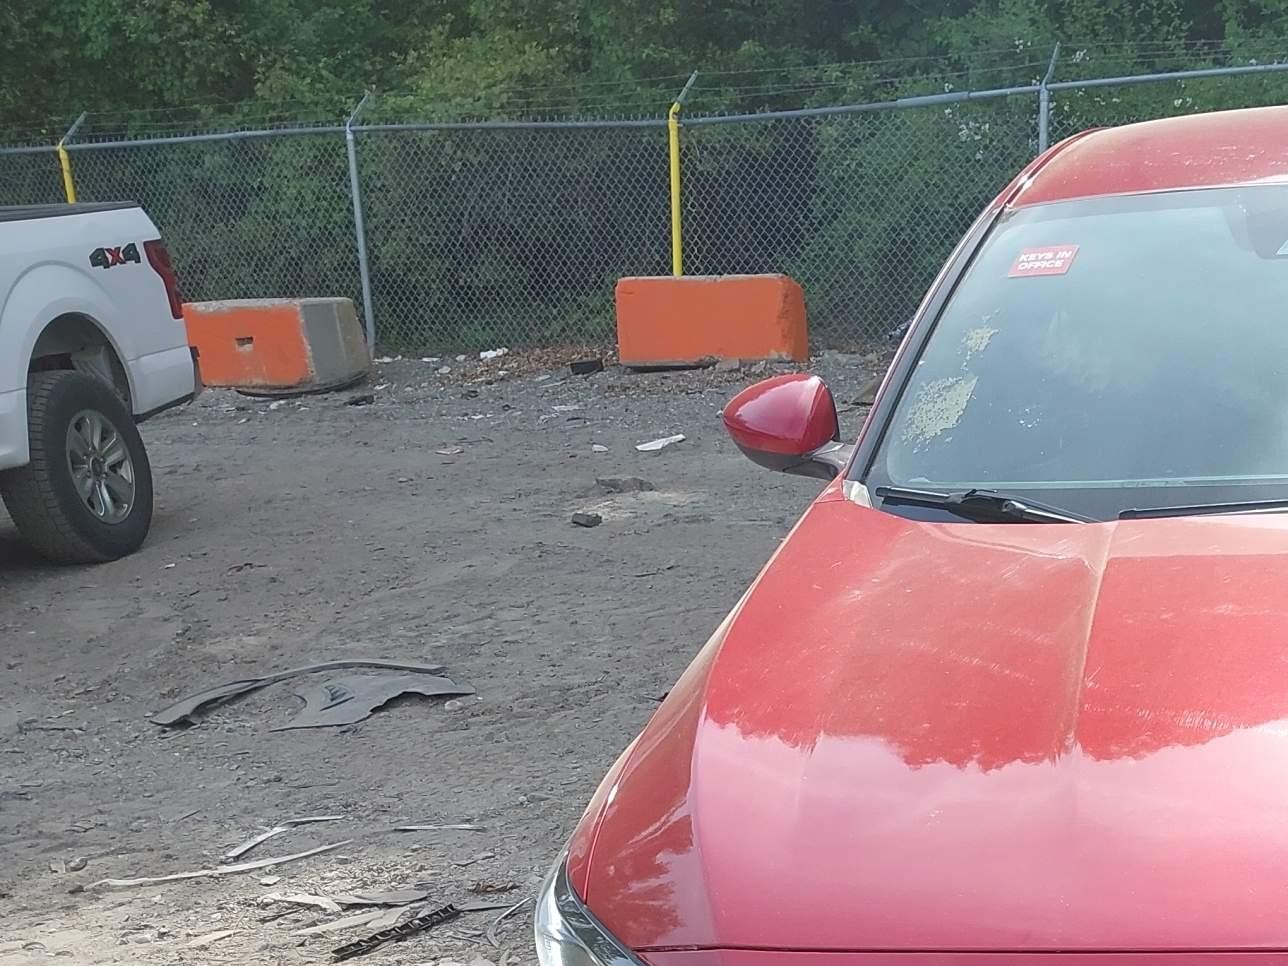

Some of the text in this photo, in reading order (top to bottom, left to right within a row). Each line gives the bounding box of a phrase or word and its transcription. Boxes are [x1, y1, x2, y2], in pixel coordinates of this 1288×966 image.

[1018, 250, 1072, 262] KEYS IN
[1018, 259, 1065, 270] OFFICE
